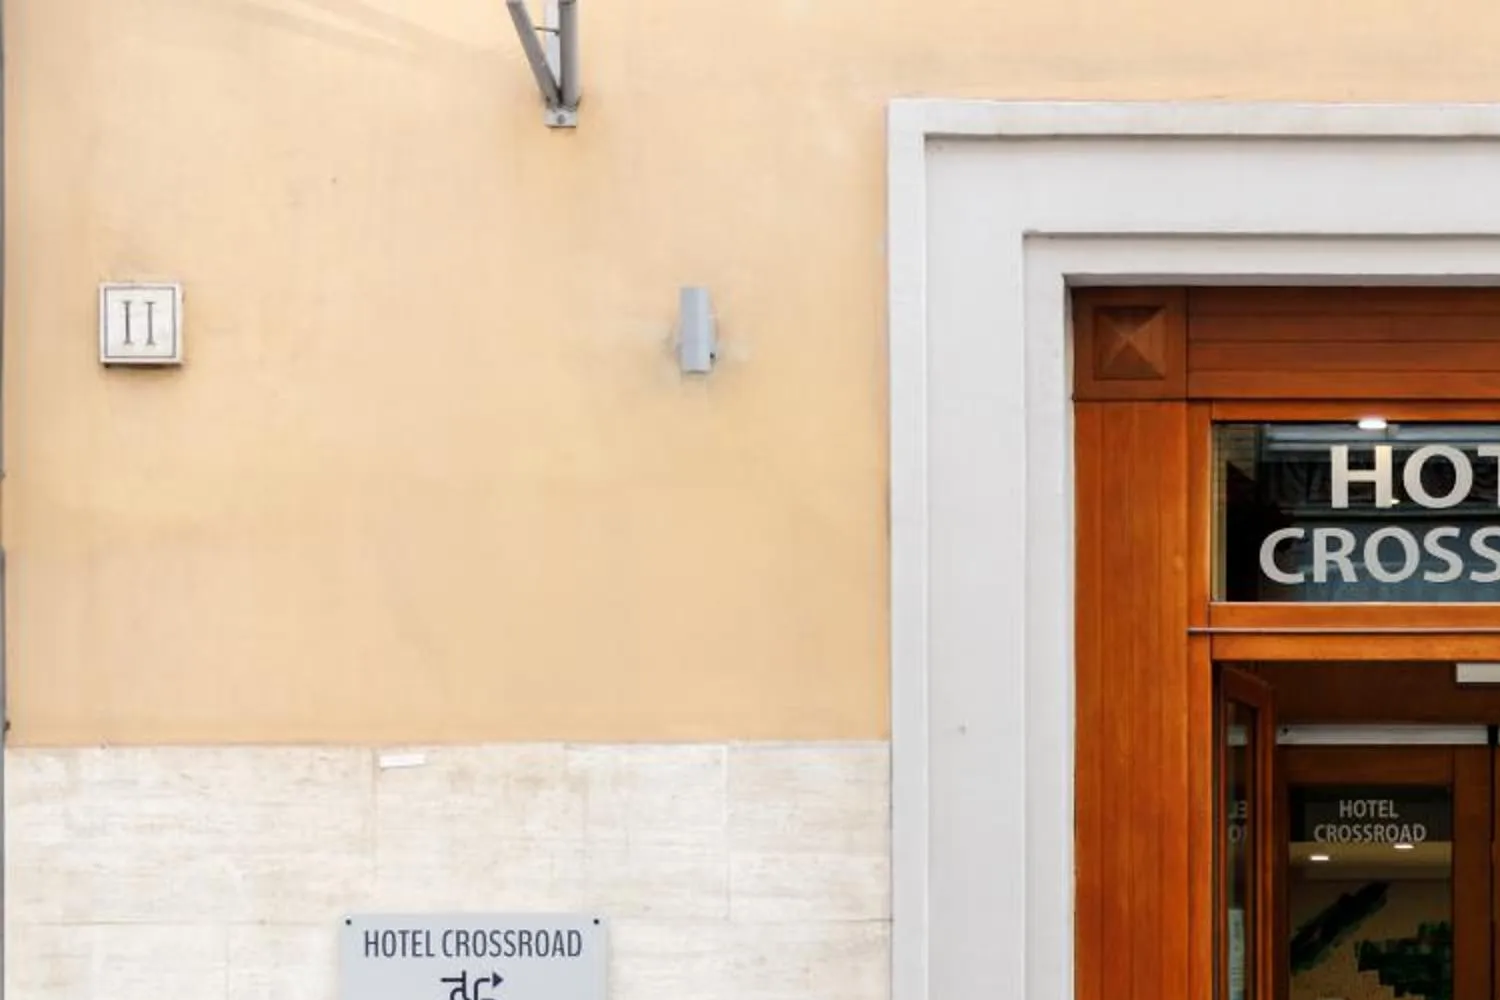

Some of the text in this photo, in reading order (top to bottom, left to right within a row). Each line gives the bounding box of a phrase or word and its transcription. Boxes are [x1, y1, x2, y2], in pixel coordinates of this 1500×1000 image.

[1339, 799, 1400, 819] HOTEL
[1313, 823, 1427, 844] CROSSROAD
[364, 929, 582, 957] HOTEL CROSSROAD
